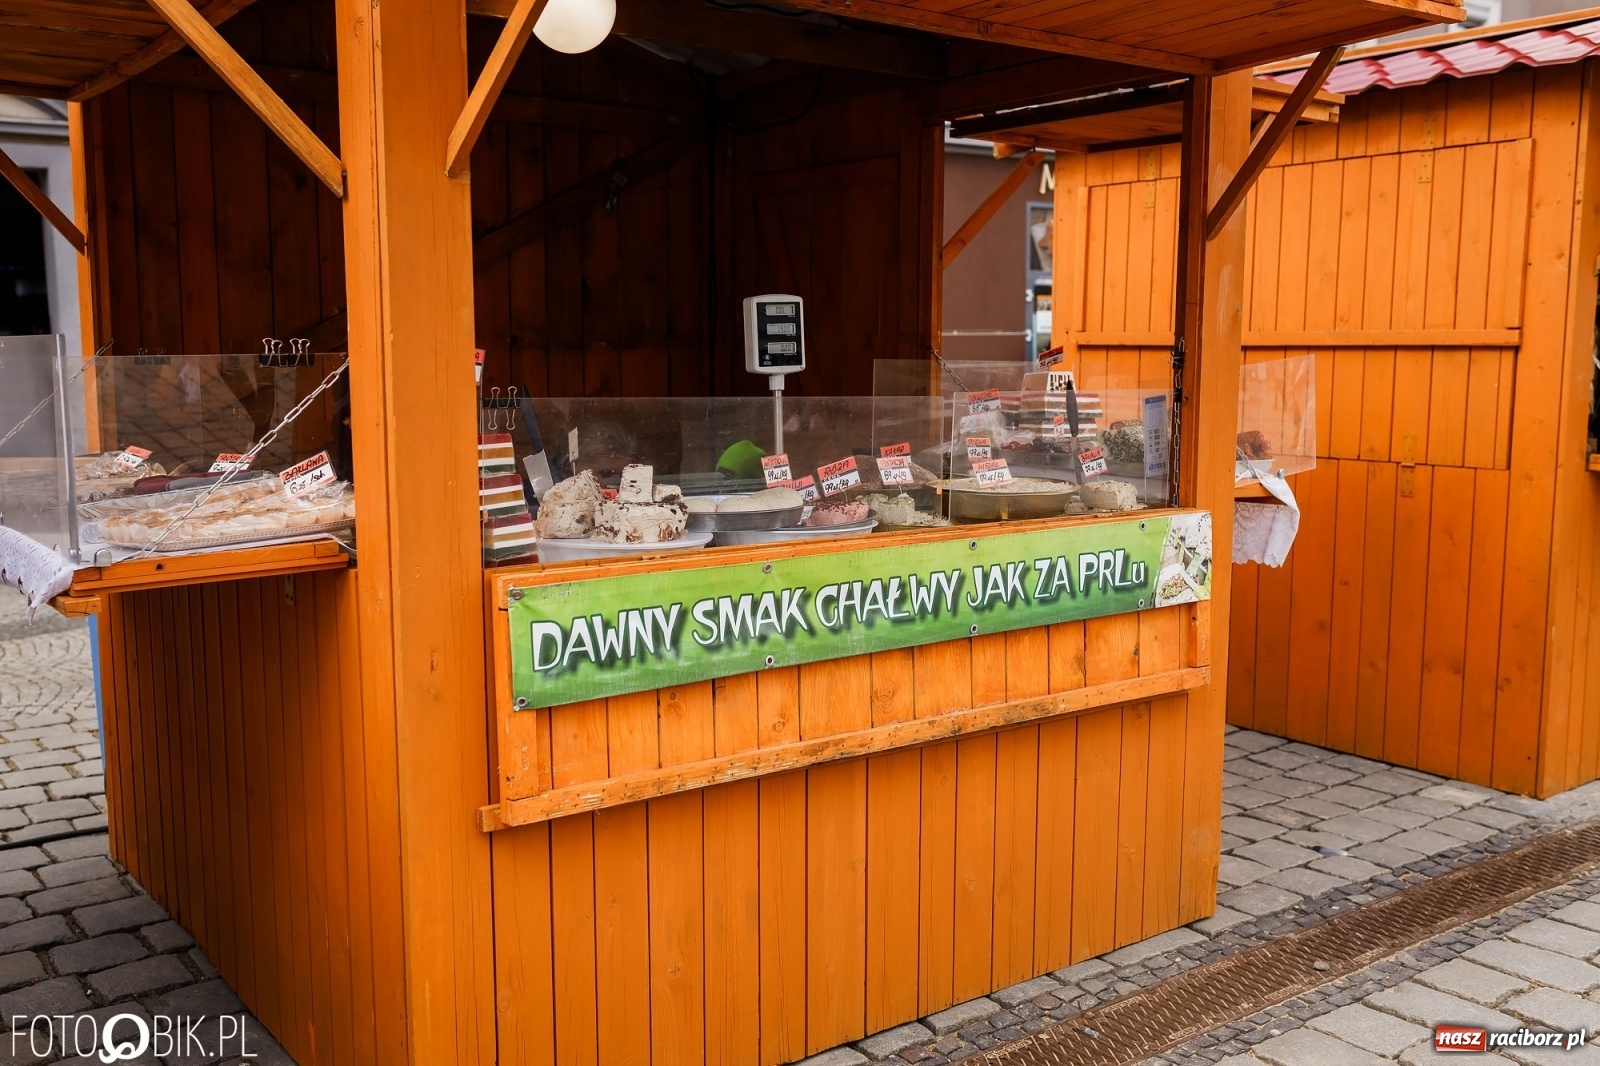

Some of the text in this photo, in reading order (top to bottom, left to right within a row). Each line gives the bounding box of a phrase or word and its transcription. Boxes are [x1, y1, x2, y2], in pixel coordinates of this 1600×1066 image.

[531, 548, 1146, 672] DAWNY SMAK CHAŁWY JAK ZA PRLu
